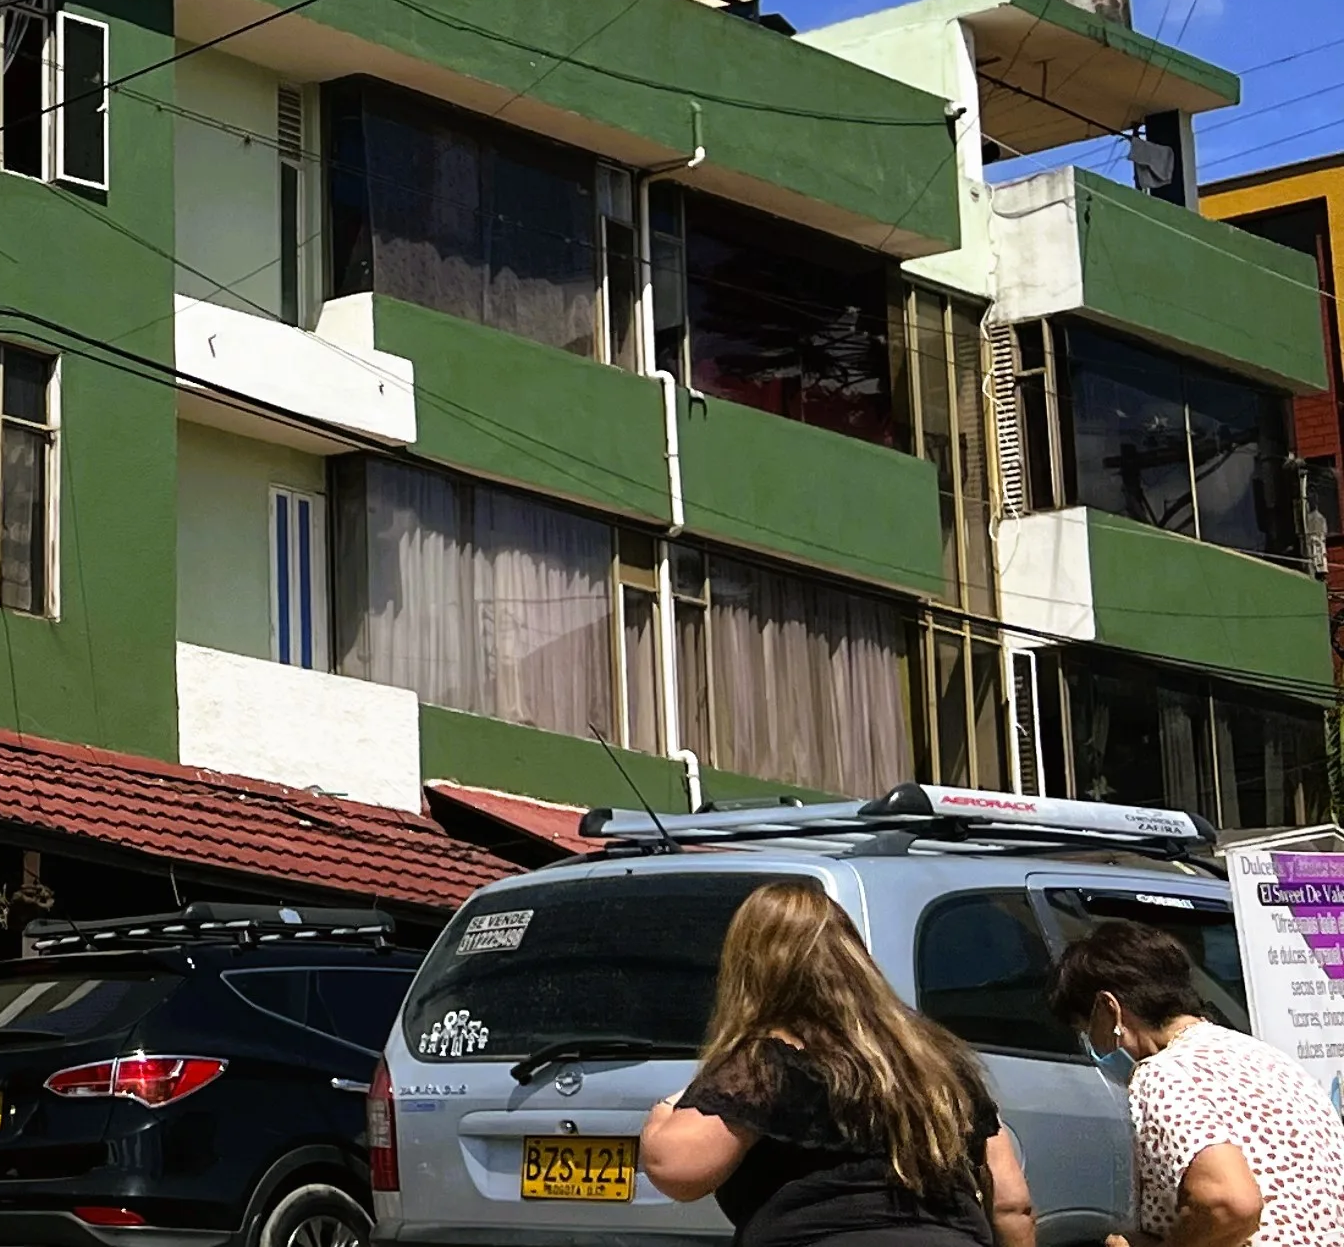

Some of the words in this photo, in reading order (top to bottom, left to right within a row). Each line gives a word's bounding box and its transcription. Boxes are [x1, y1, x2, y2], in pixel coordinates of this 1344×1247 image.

[941, 795, 1036, 812] AERORACK
[1260, 884, 1272, 903] El
[1273, 884, 1305, 903] Street
[1306, 885, 1322, 903] De
[526, 1146, 574, 1182] BZS
[582, 1147, 626, 1183] 121
